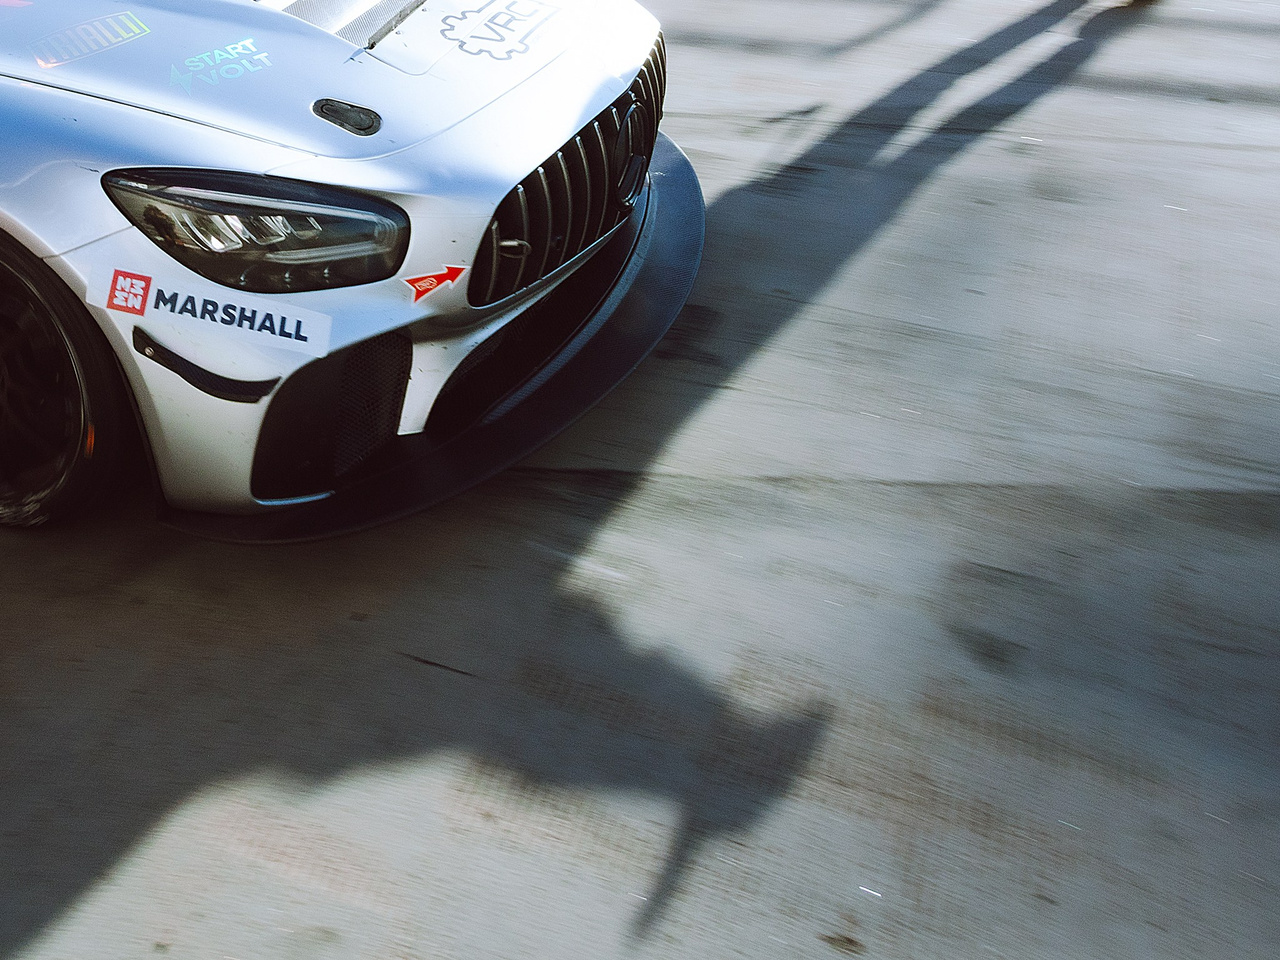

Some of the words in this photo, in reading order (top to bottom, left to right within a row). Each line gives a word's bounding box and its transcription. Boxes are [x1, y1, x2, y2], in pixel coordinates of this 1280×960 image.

[469, 0, 540, 43] VRC
[184, 38, 258, 72] START
[197, 52, 274, 86] VOLT
[154, 288, 308, 343] MARSHALL
